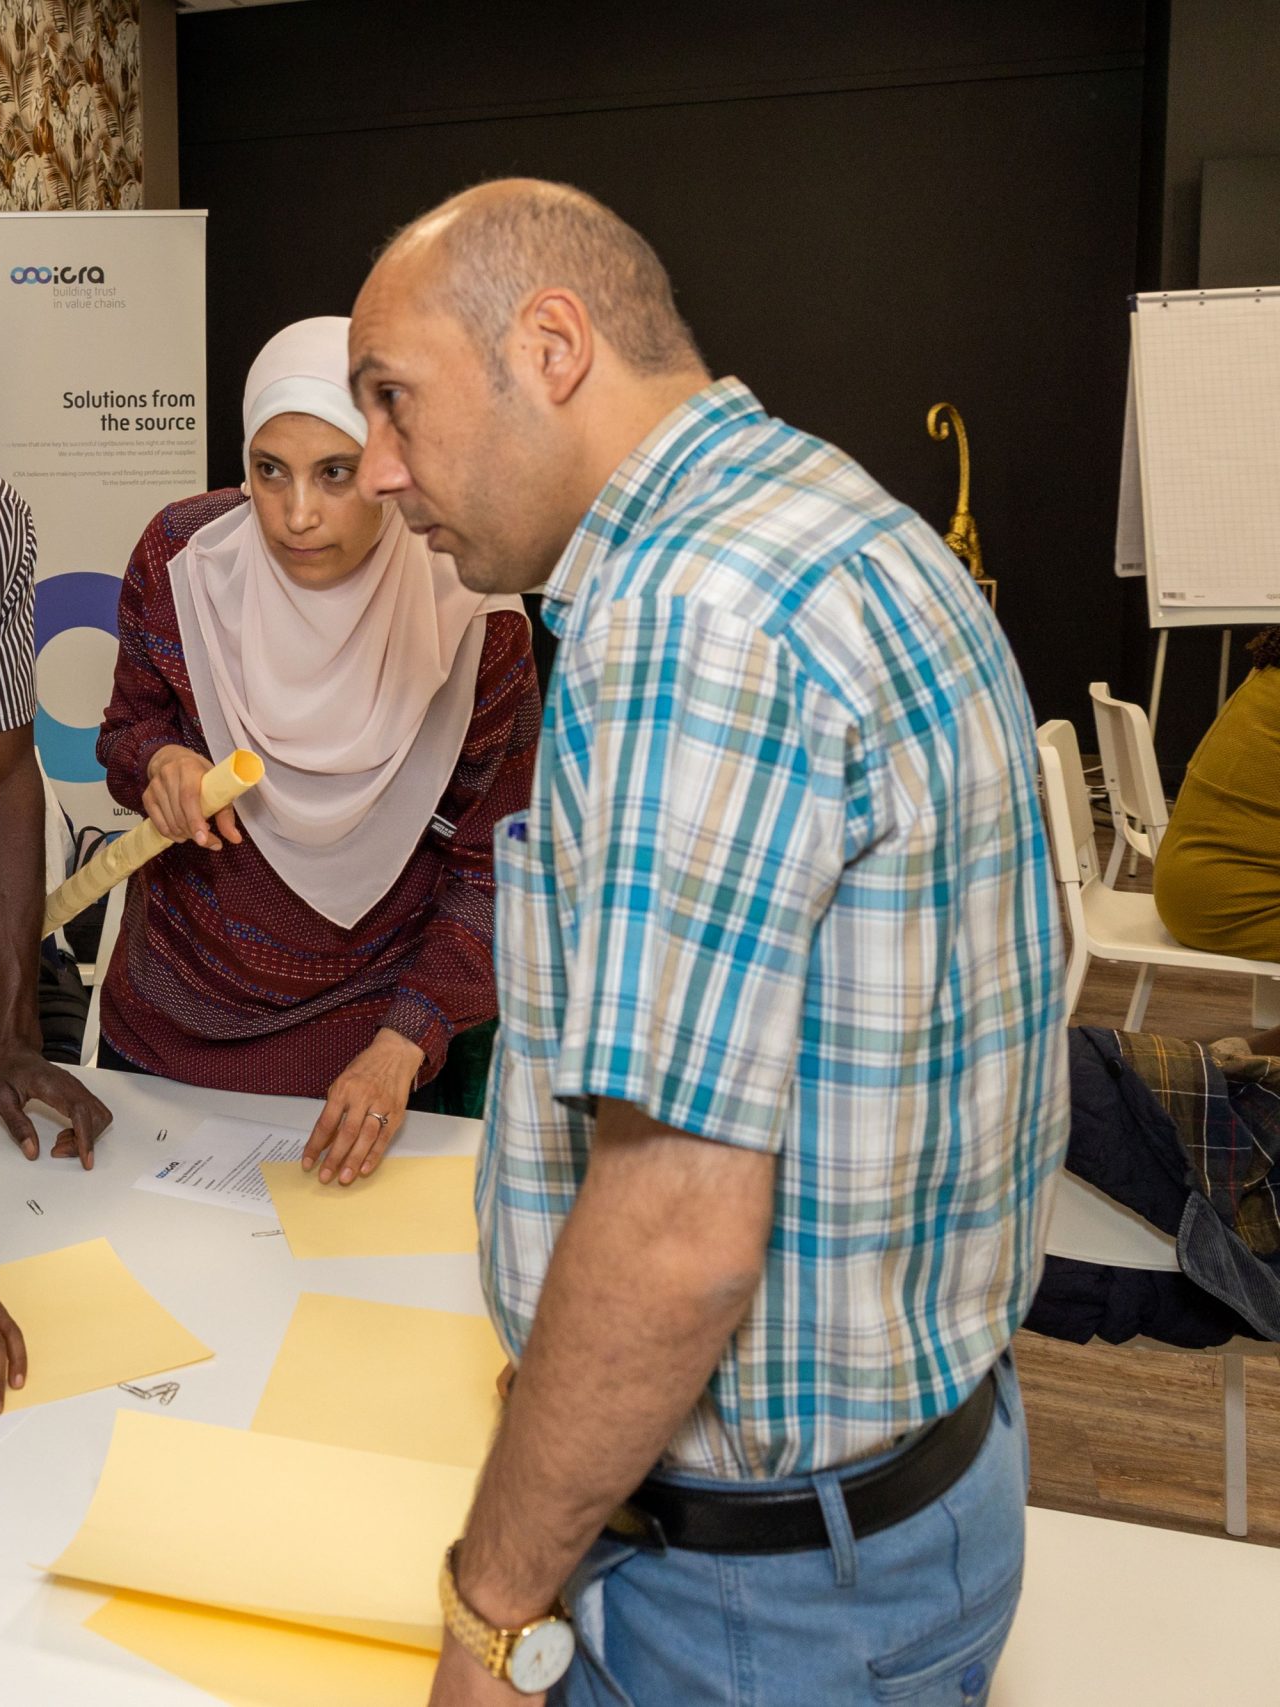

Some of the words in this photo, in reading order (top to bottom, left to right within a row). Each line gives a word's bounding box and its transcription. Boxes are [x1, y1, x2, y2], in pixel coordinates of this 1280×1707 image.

[53, 266, 104, 284] icra
[53, 287, 92, 299] building
[94, 287, 116, 297] trust
[53, 300, 62, 309] in
[65, 299, 92, 309] value
[94, 299, 127, 309] chains
[63, 391, 147, 409] Solutions
[152, 390, 195, 408] from
[101, 414, 130, 431] the
[135, 416, 195, 430] source
